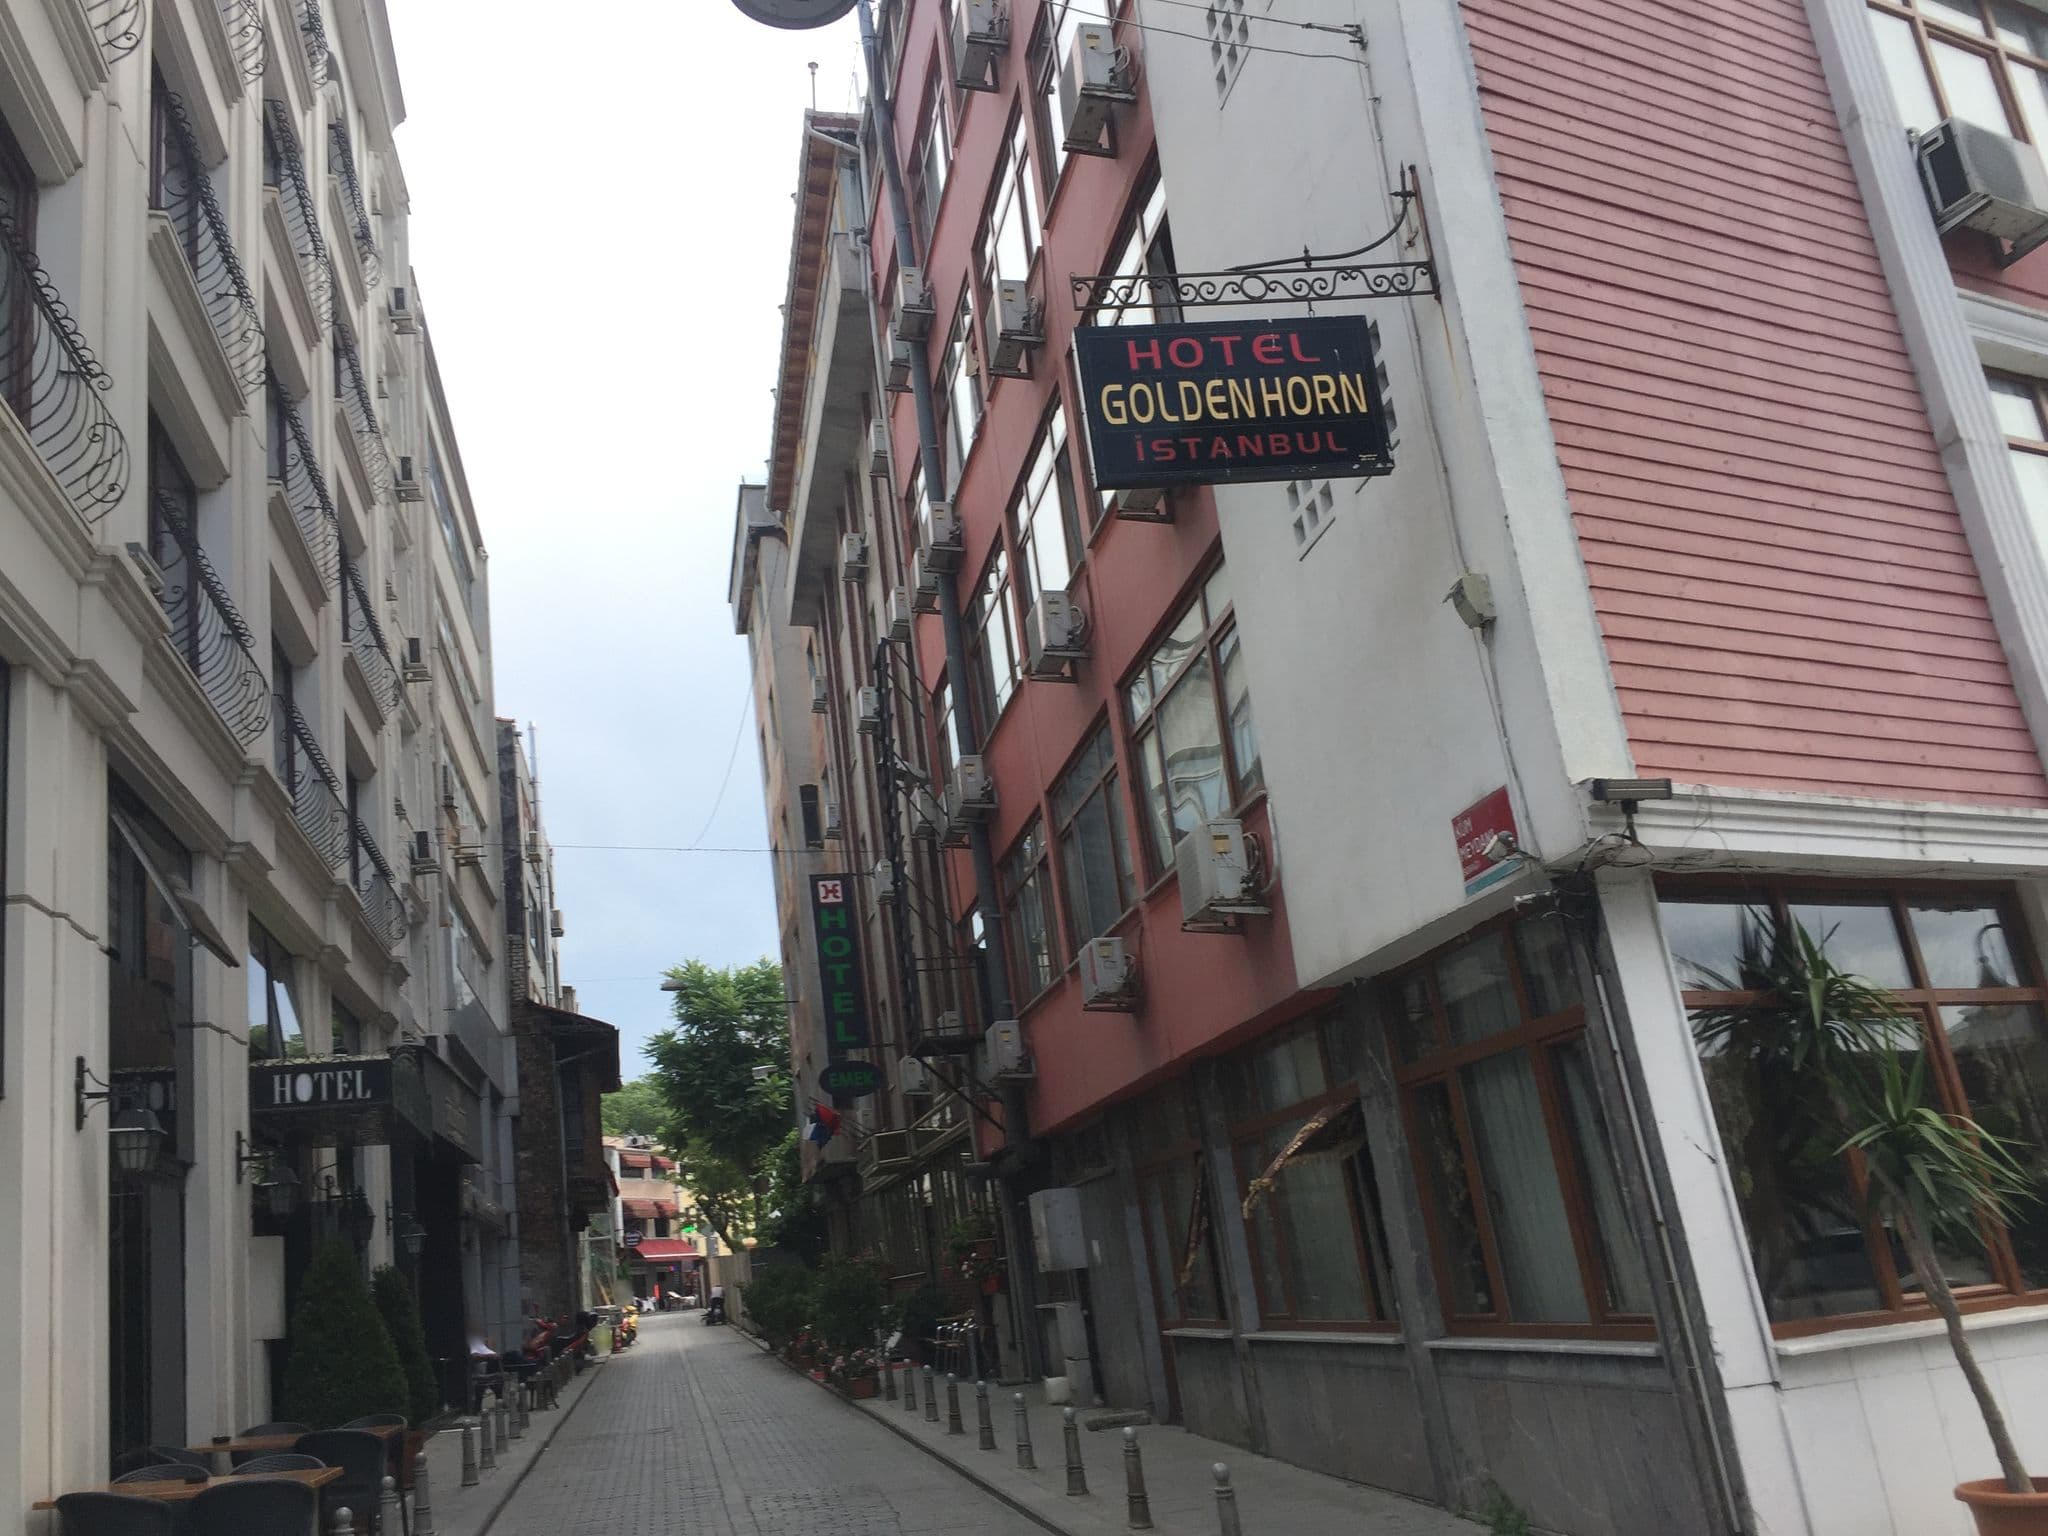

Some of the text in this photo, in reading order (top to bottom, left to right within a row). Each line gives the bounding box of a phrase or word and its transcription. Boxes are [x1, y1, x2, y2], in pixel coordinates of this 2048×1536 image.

[1127, 333, 1321, 370] HOTEL
[820, 907, 857, 1042] HOTEL
[273, 1070, 372, 1104] HOTEL
[828, 1071, 875, 1088] EMEK
